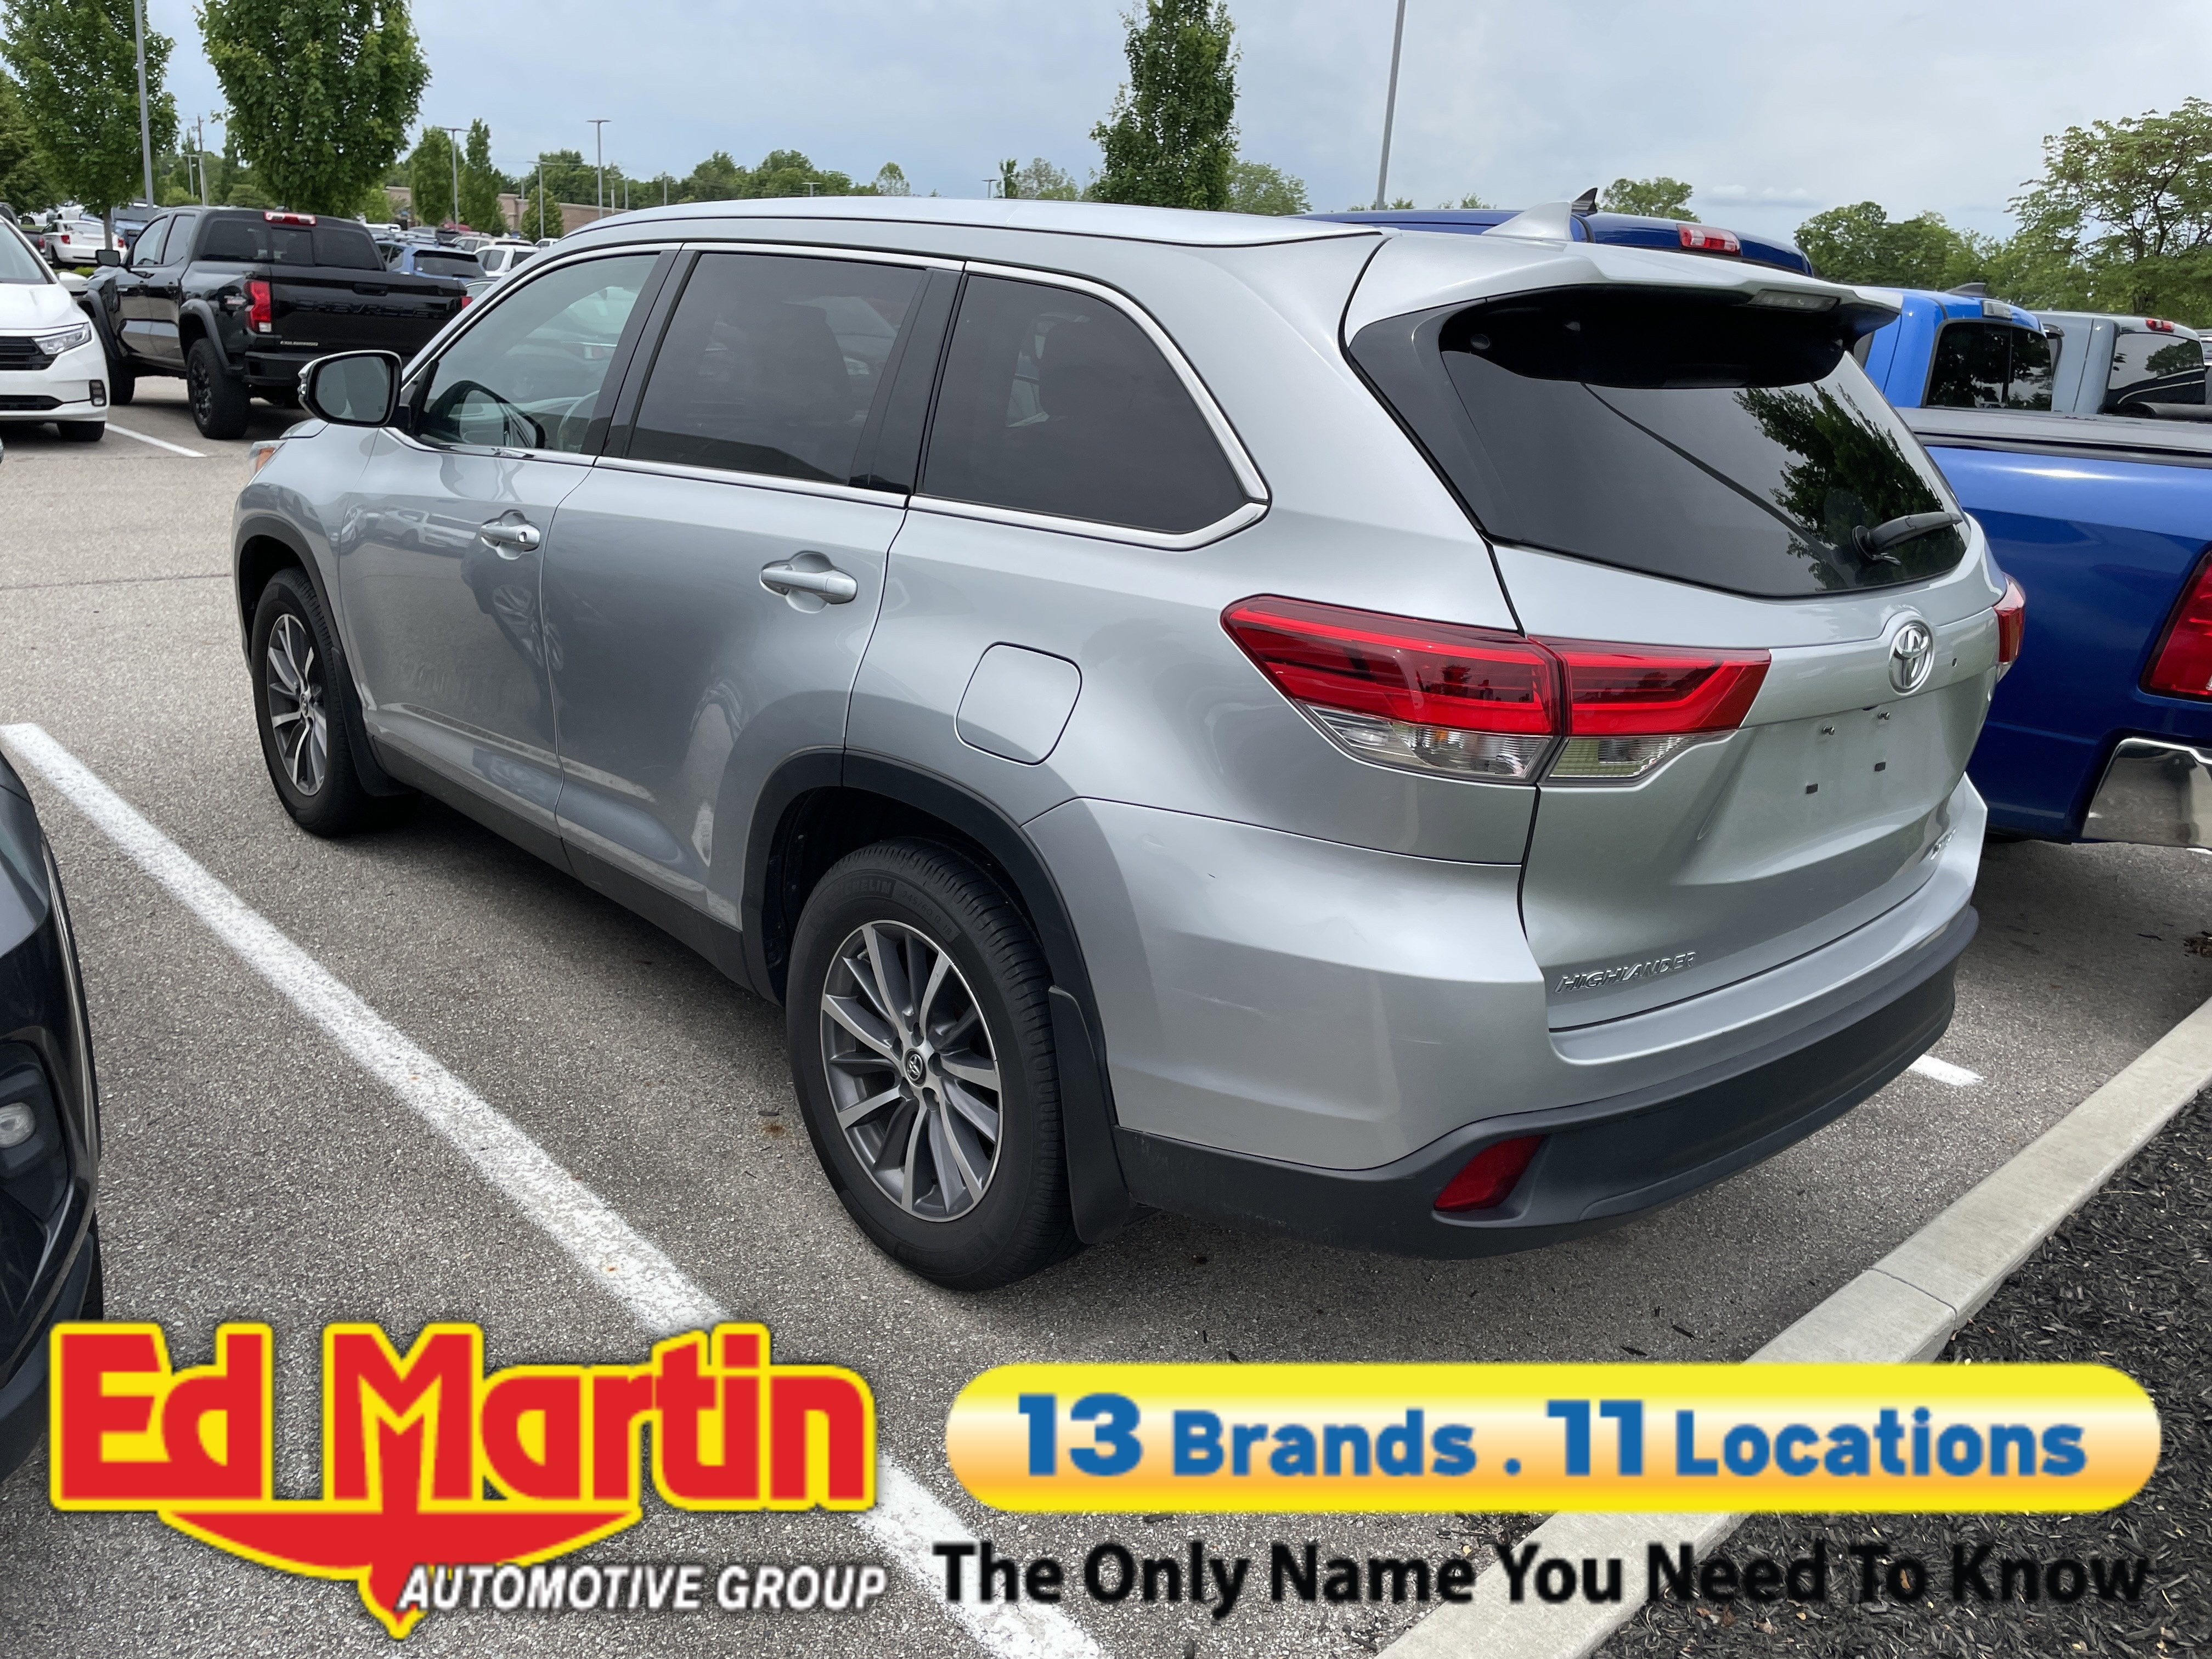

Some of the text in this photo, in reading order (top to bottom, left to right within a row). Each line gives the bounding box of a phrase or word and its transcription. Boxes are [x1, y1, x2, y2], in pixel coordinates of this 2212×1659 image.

[831, 879, 891, 899] ICHELIN
[901, 890, 934, 917] 245/60
[1555, 951, 1696, 993] HIGHLANDER
